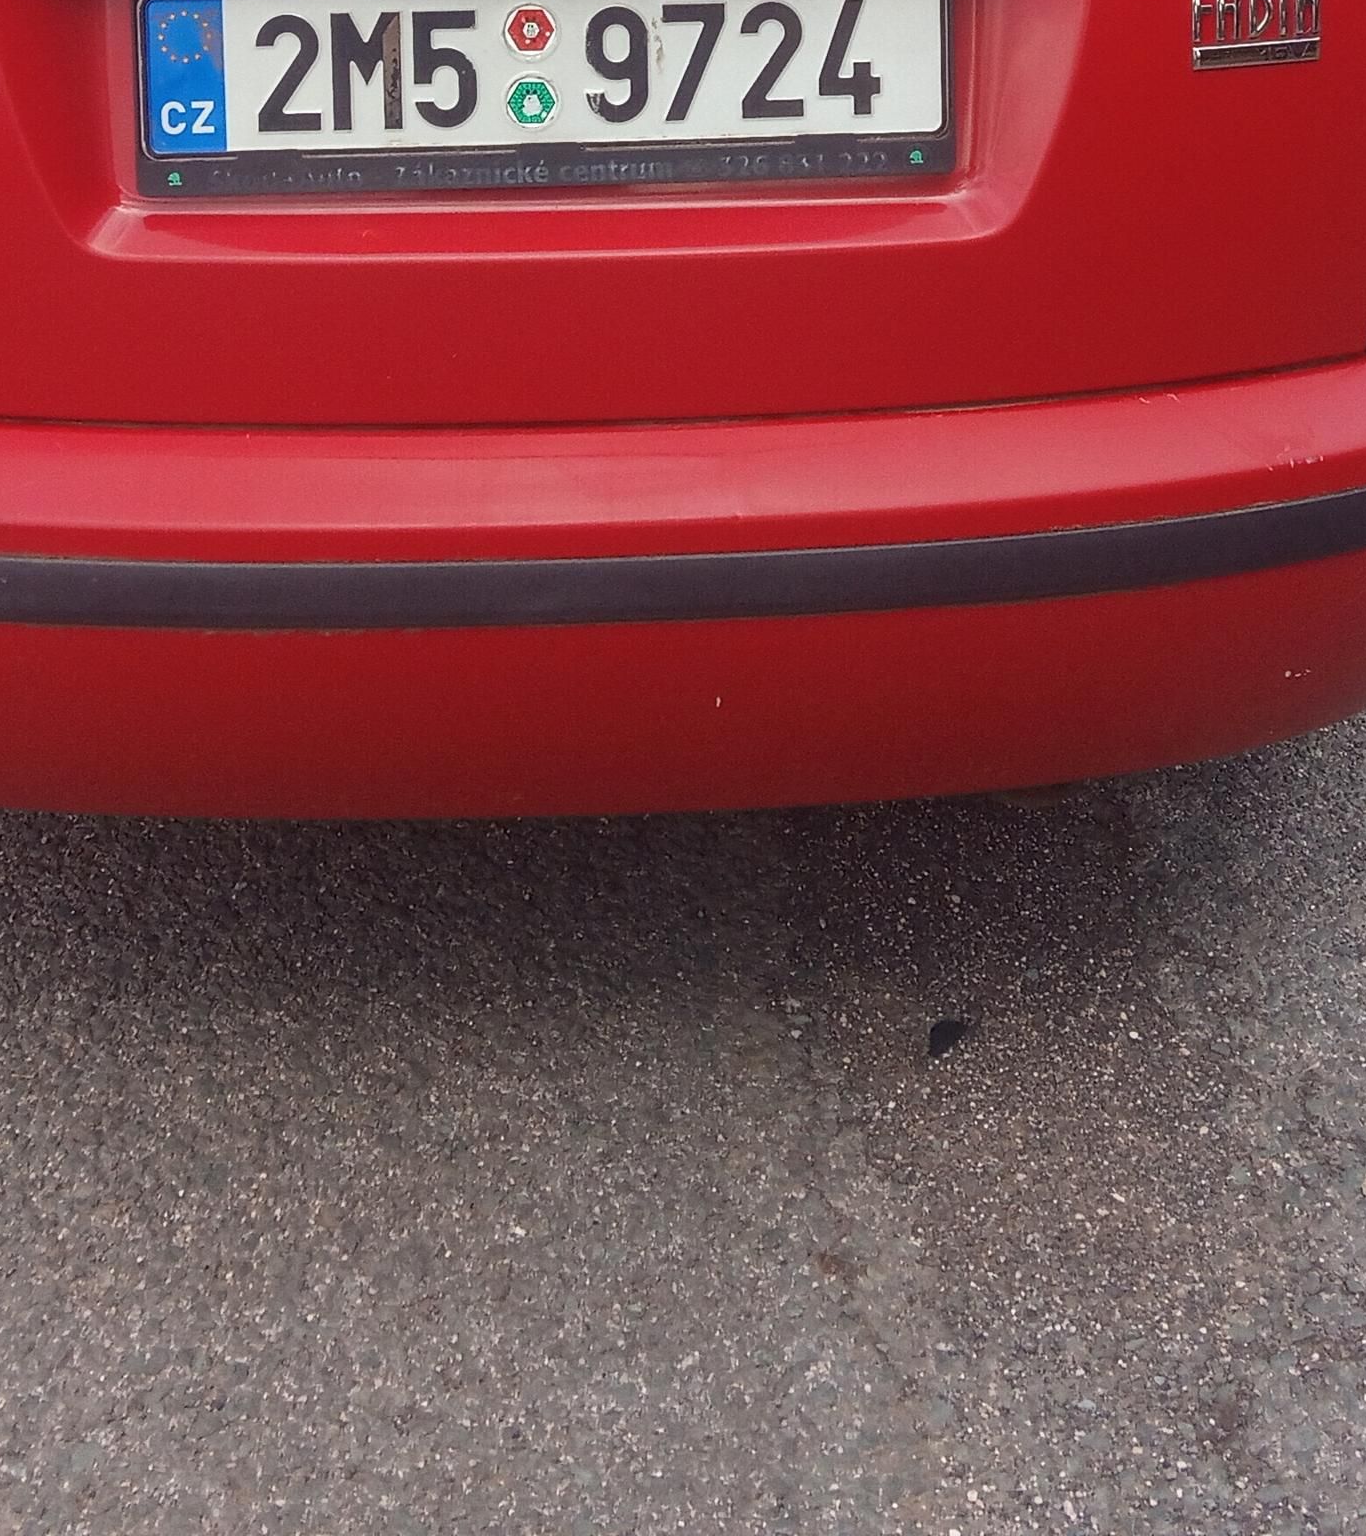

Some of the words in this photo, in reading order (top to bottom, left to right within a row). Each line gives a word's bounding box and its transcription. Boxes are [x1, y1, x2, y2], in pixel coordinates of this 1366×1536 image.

[161, 101, 216, 136] CZ
[255, 9, 478, 133] 2M5
[560, 160, 673, 184] centrum
